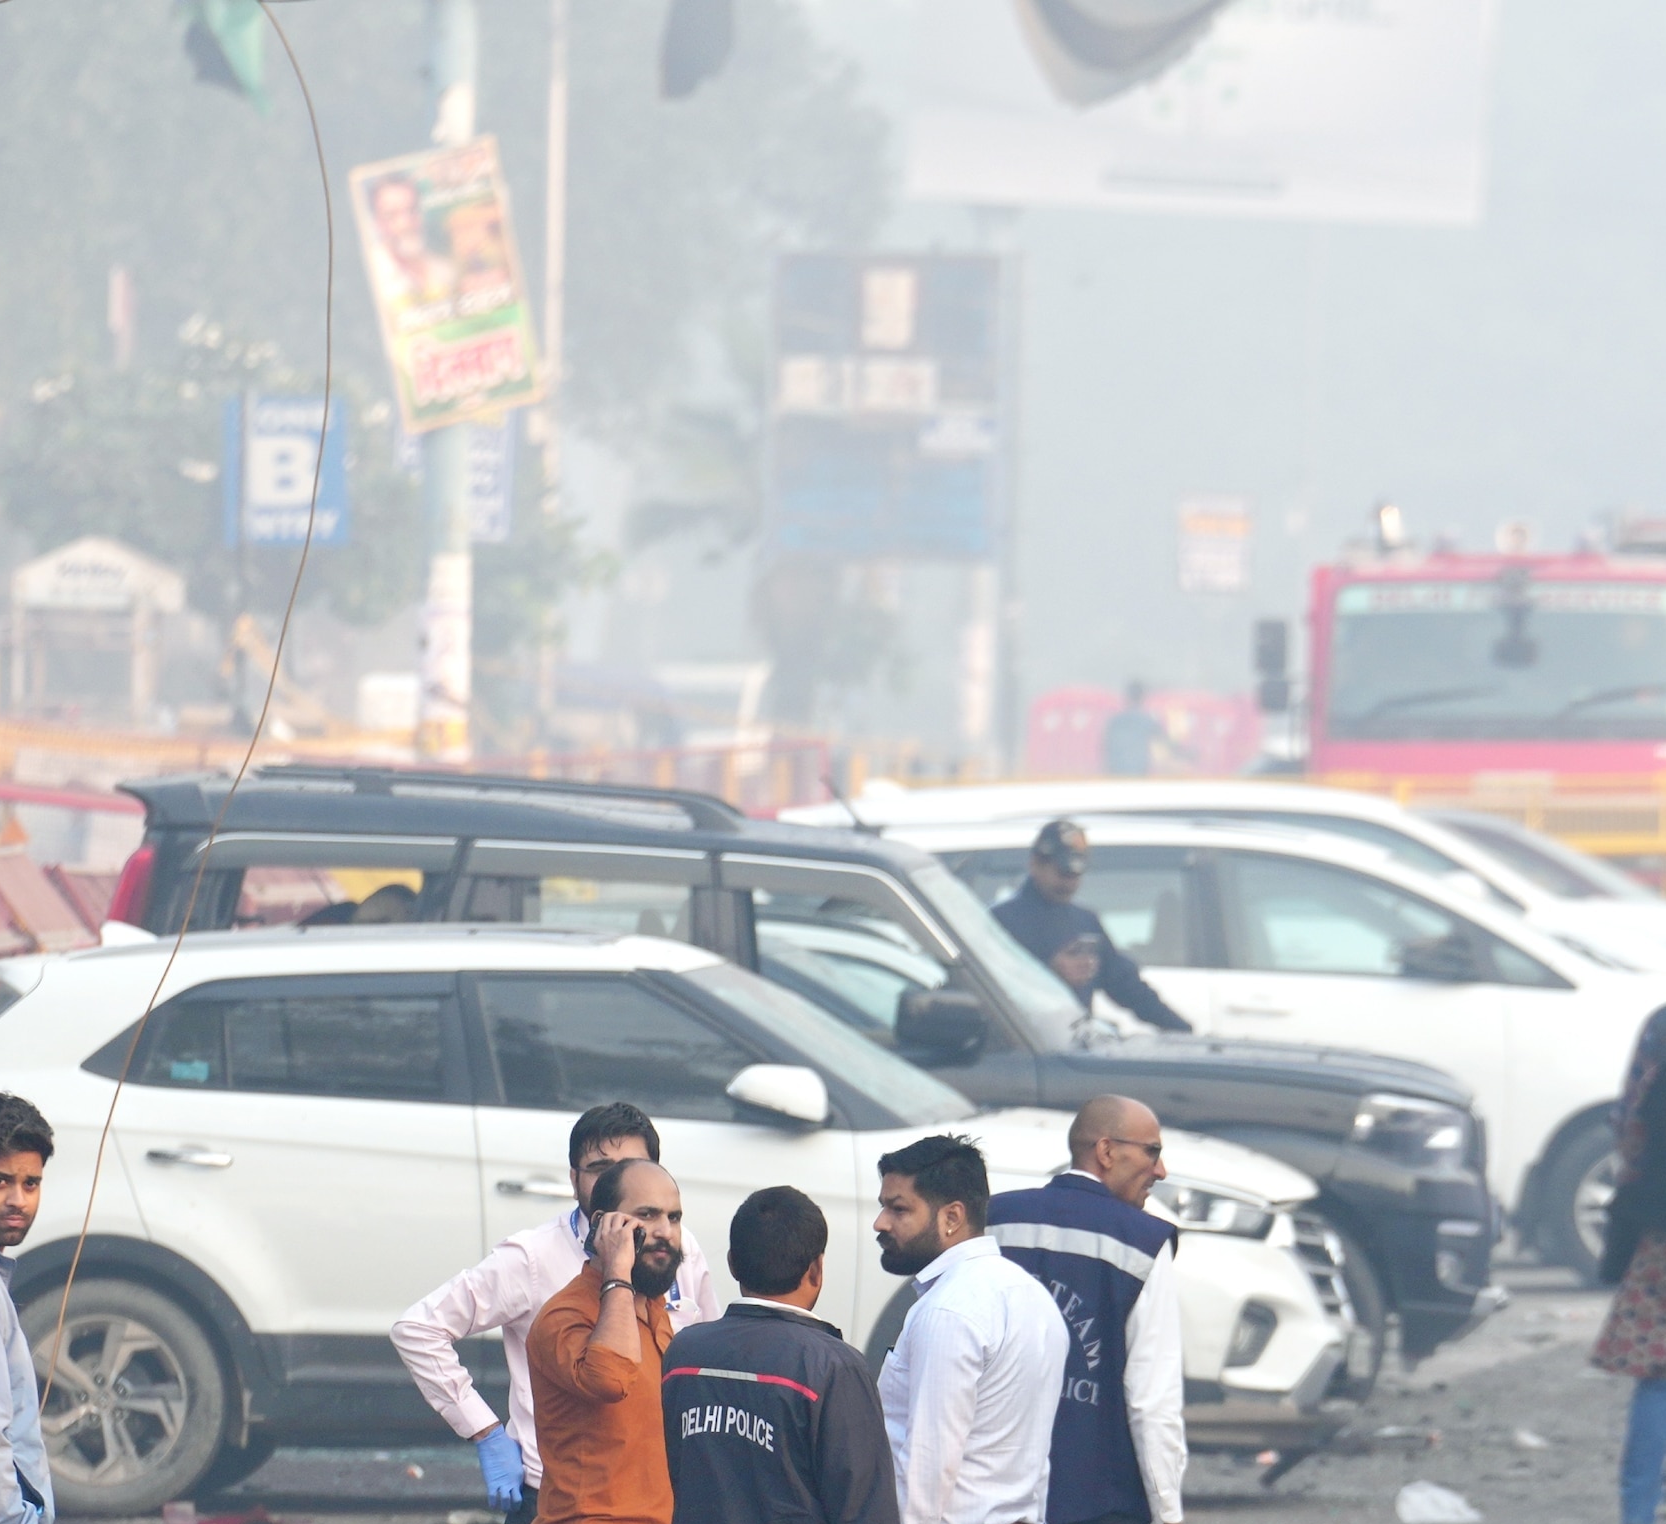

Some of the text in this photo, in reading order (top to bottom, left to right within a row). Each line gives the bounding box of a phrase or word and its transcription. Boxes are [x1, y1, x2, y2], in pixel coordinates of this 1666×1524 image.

[247, 436, 322, 505] B
[247, 510, 339, 540] NTRY
[1049, 1279, 1101, 1371] TEAM
[681, 1404, 774, 1452] DELHI POLICE
